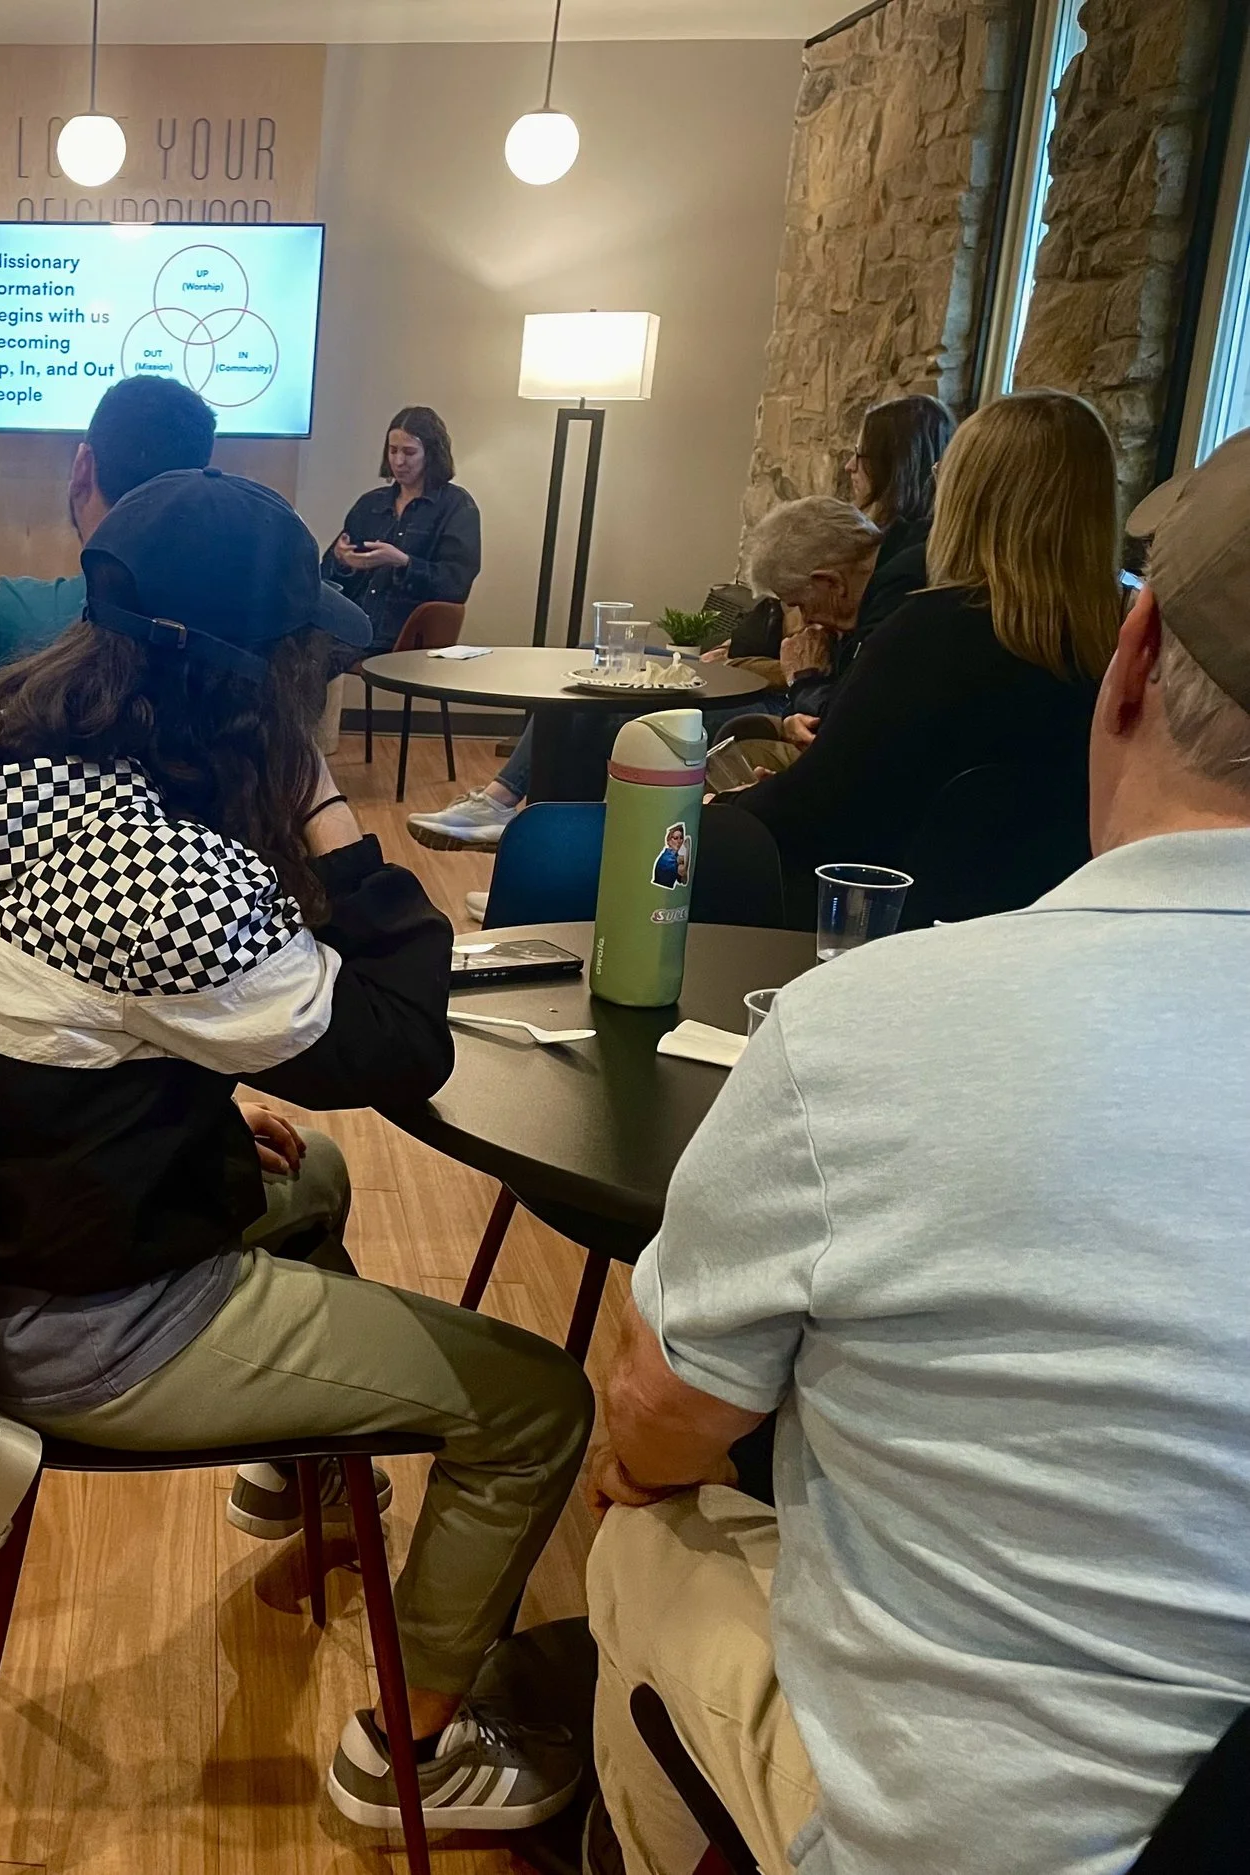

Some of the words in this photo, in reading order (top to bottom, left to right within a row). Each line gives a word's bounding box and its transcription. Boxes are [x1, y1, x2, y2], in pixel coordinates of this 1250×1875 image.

[157, 117, 276, 181] YOUR
[196, 269, 209, 278] UP
[182, 282, 224, 293] (Worship)
[48, 307, 85, 323] with
[90, 312, 110, 324] us
[143, 349, 163, 358] OUT
[238, 351, 249, 359] IN
[20, 360, 41, 377] In,
[46, 361, 78, 376] and
[83, 361, 115, 377] Out
[134, 362, 173, 372] (Mission)
[215, 363, 273, 375] (Community)
[595, 936, 605, 975] owala
